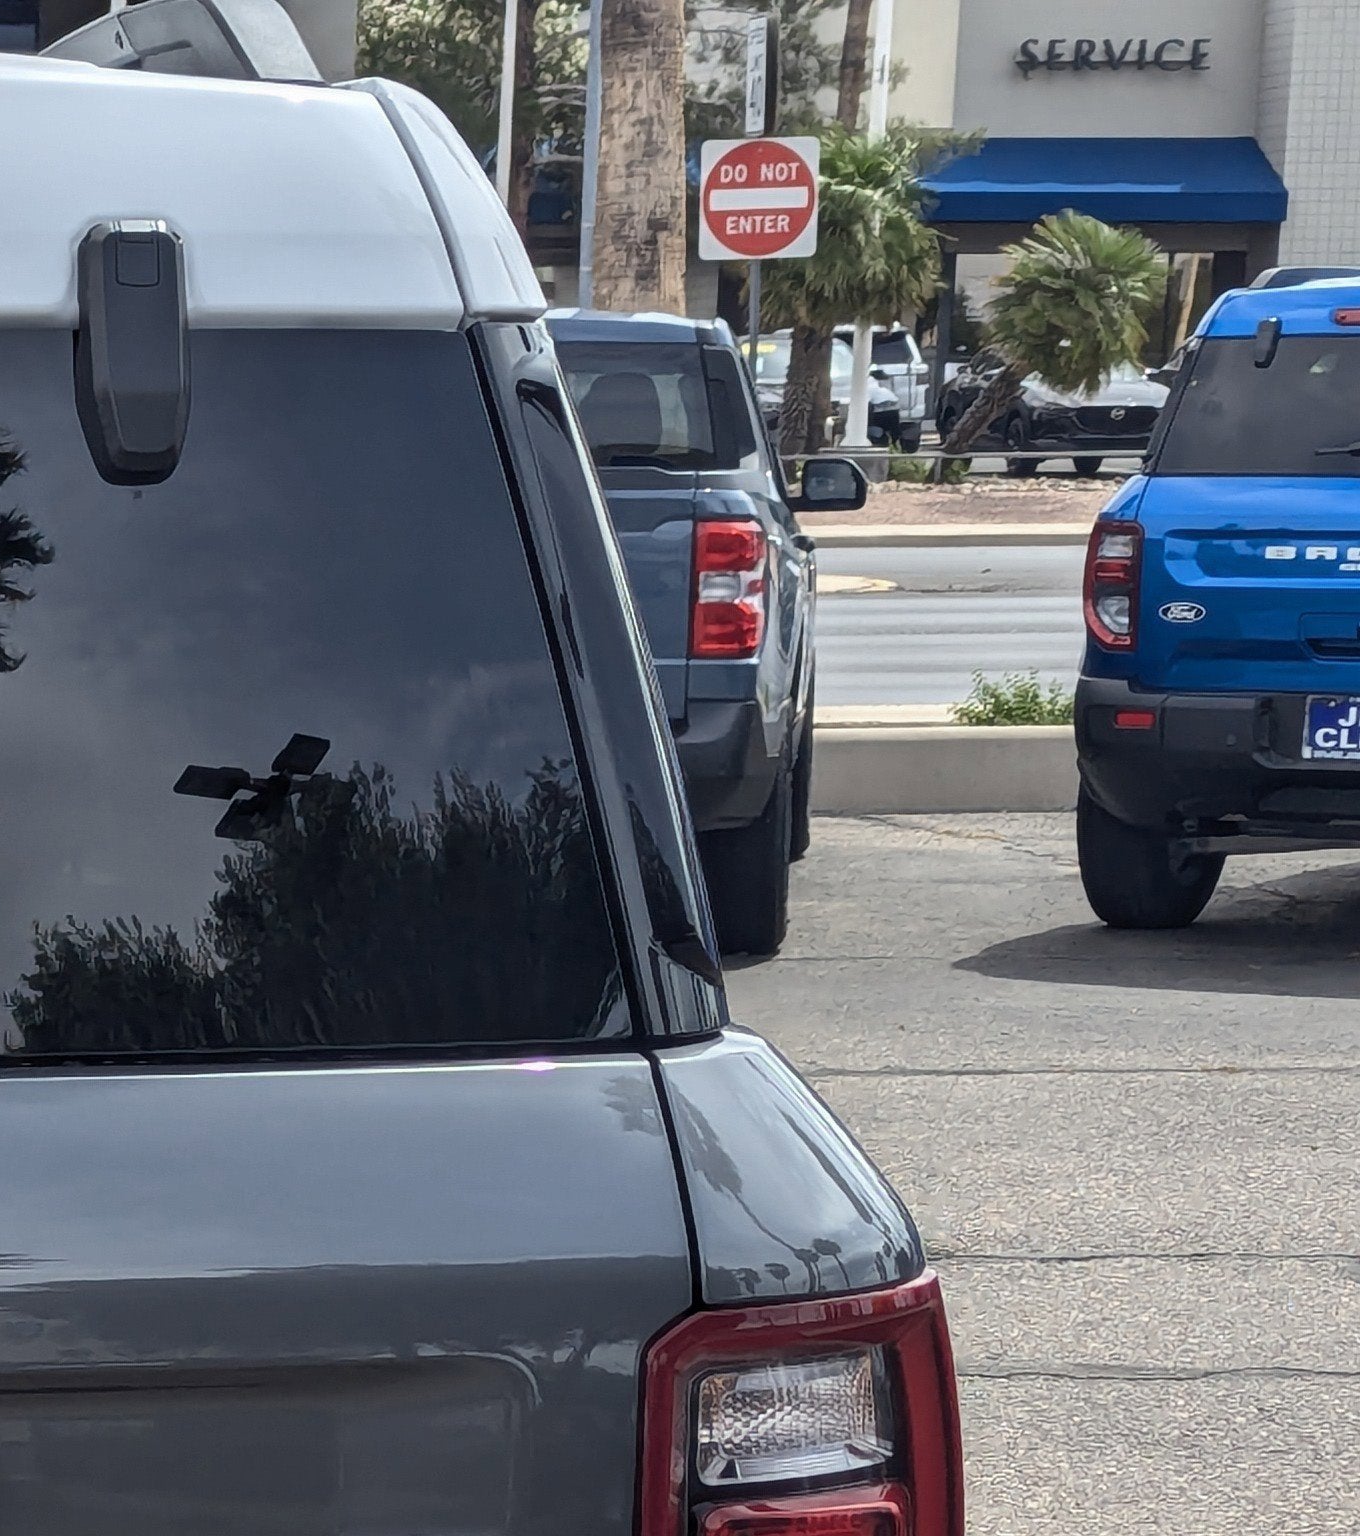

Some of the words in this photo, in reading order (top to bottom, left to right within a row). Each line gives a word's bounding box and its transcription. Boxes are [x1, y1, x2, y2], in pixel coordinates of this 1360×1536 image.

[1017, 38, 1212, 72] SERVICE
[720, 164, 748, 183] DO
[760, 162, 800, 182] NOT
[725, 215, 790, 235] ENTER
